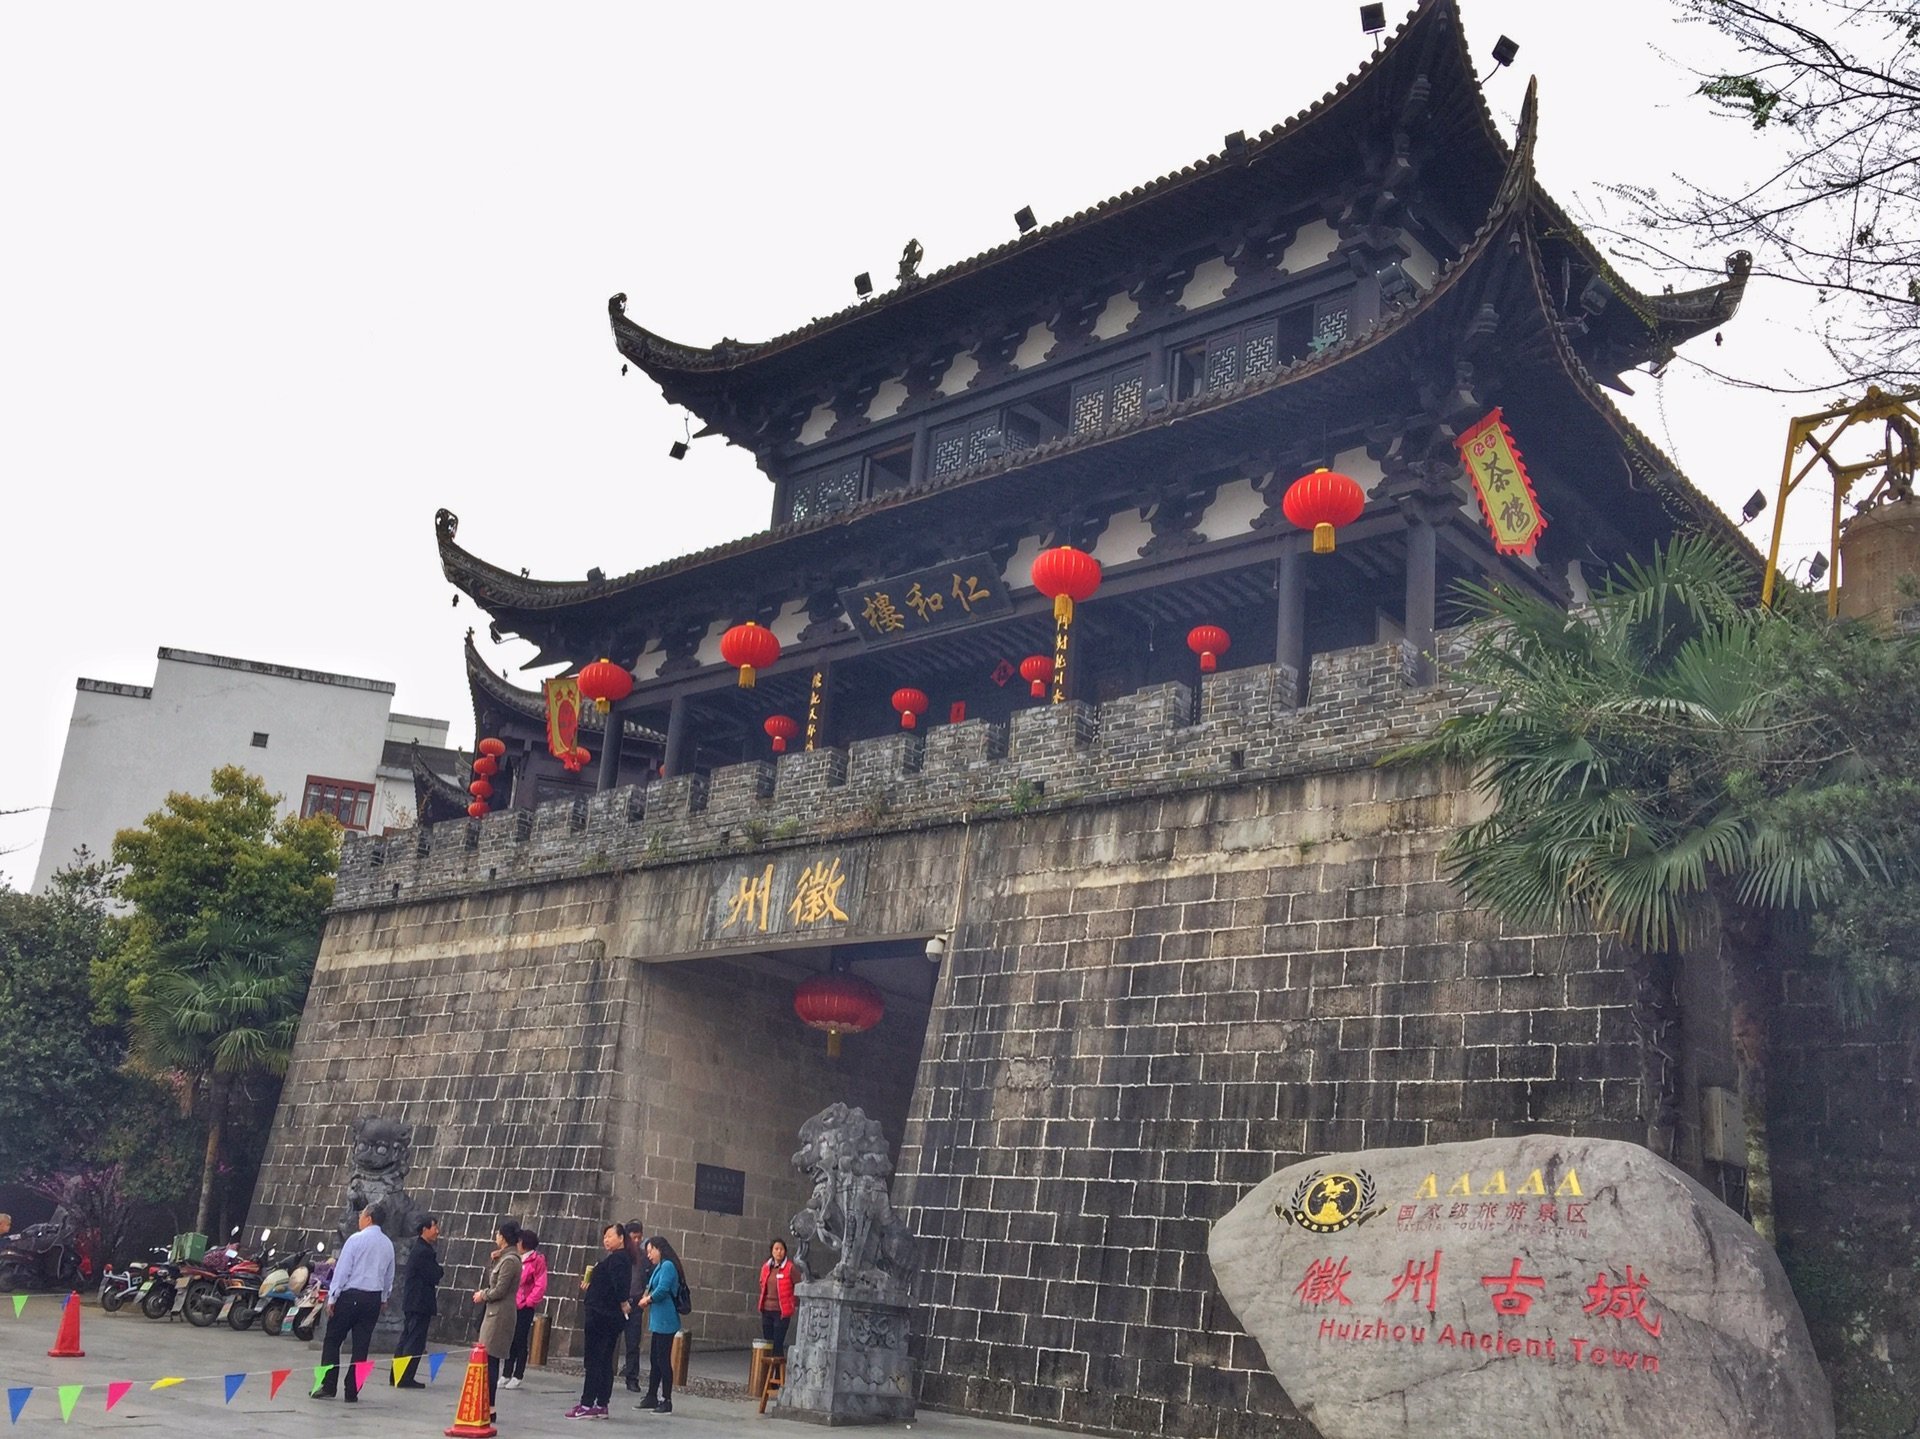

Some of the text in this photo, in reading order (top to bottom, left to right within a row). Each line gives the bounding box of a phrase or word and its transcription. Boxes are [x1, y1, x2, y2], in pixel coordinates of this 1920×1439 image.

[1398, 1202, 1591, 1223] 国家级旅游景区
[1293, 1249, 1662, 1338] 徽州古城
[1318, 1317, 1660, 1373] Huizhou Ancient Town
